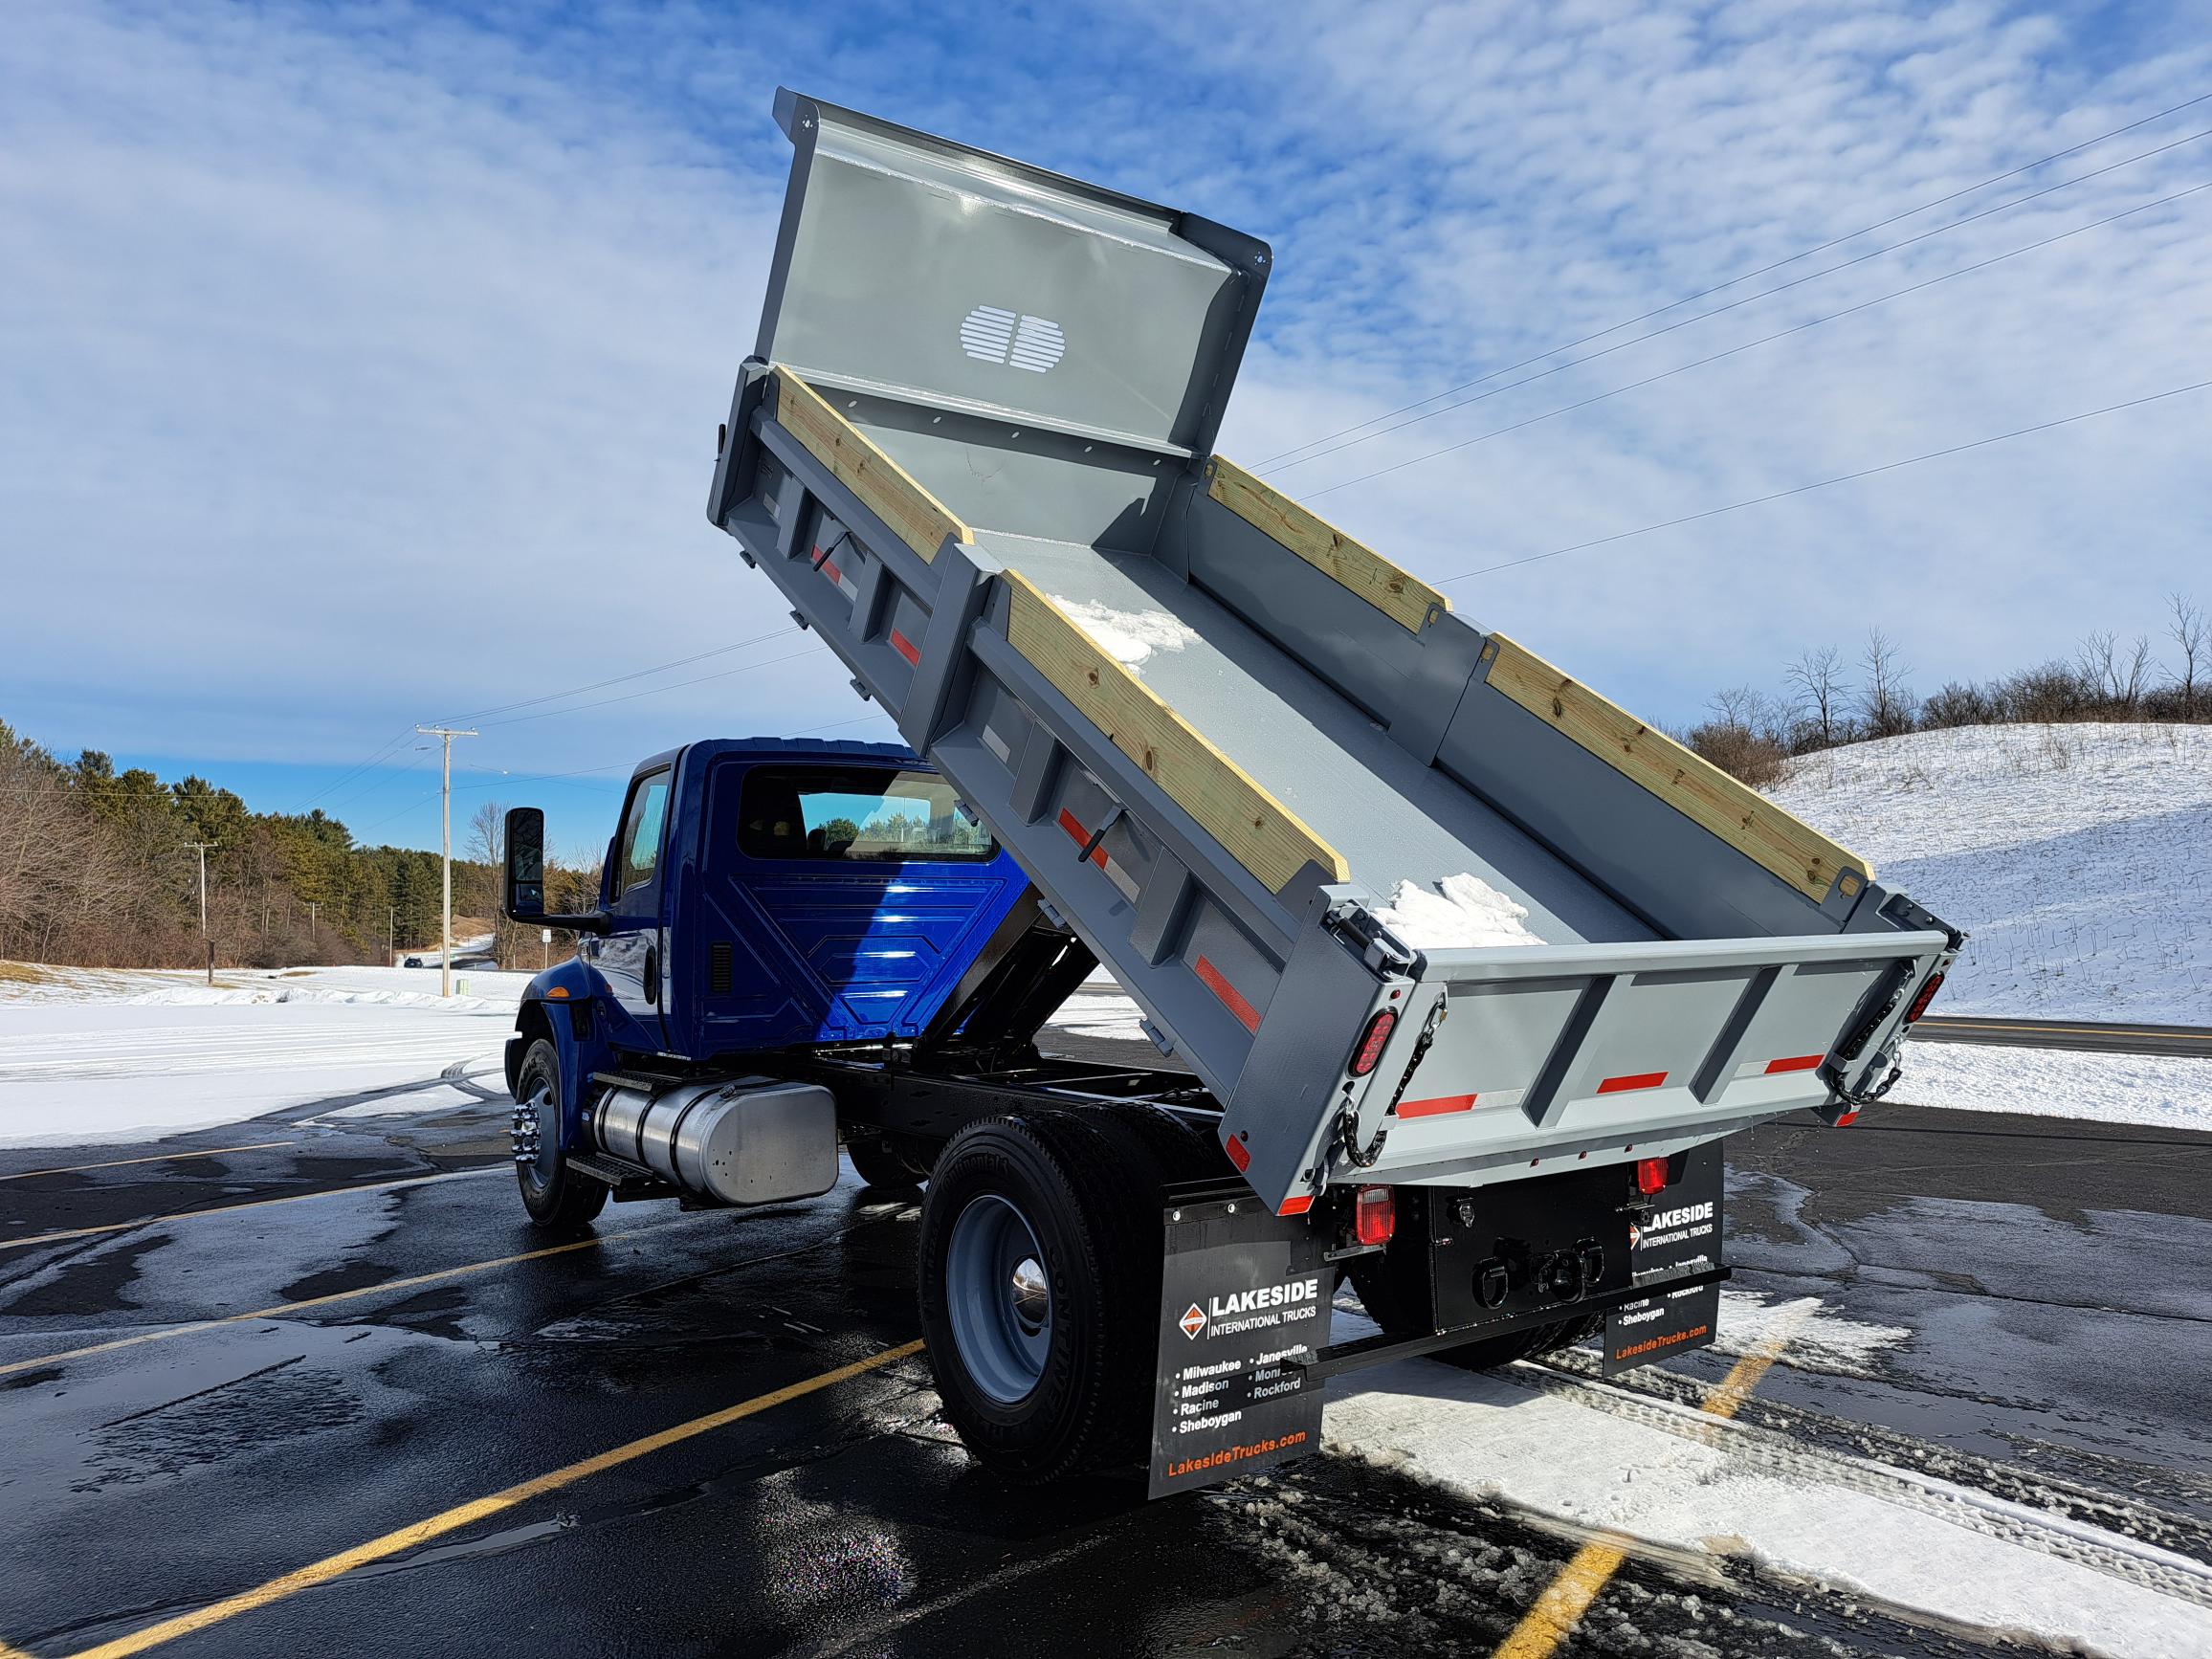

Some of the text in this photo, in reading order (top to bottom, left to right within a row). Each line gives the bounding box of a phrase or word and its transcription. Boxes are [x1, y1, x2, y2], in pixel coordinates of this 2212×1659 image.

[1643, 1224, 1713, 1250] INTERNATIONAL TRUCKS
[1212, 1278, 1318, 1317] LAKESIDE
[1210, 1306, 1316, 1337] INTERNATIONAL TRUCKS
[1623, 1308, 1665, 1326] Sheboygan
[1616, 1325, 1707, 1360] LakesideTrucks.com
[1183, 1360, 1242, 1381] Milwaukee
[1255, 1368, 1294, 1382] Monr
[1182, 1380, 1229, 1399] Madison
[1253, 1378, 1301, 1400] Rockford
[1181, 1399, 1220, 1416] Racine
[1180, 1410, 1242, 1434] Sheboygan
[1168, 1430, 1306, 1477] LakesideTrucks.com
